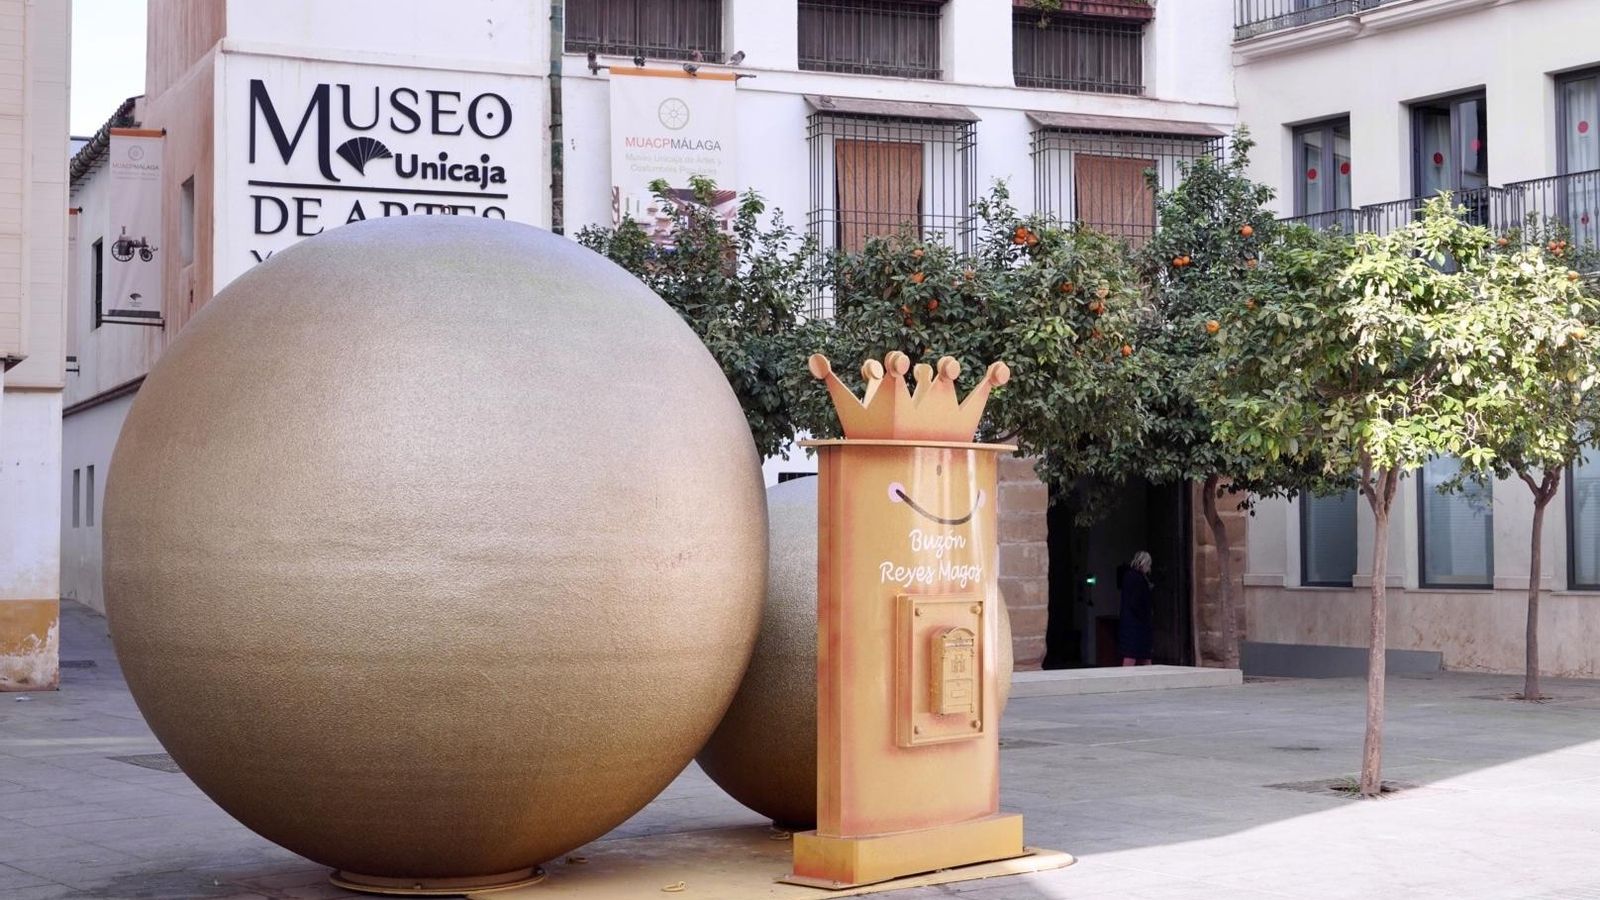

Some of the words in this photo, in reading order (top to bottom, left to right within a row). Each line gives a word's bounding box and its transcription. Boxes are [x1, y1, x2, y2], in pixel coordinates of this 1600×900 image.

[249, 78, 512, 182] MUSEO
[625, 136, 722, 151] MUACPMÁLAGA
[395, 151, 507, 190] Unicaja
[250, 194, 325, 236] DE
[909, 529, 967, 559] Buzón
[879, 561, 936, 588] Reyes
[938, 560, 983, 589] Magos
